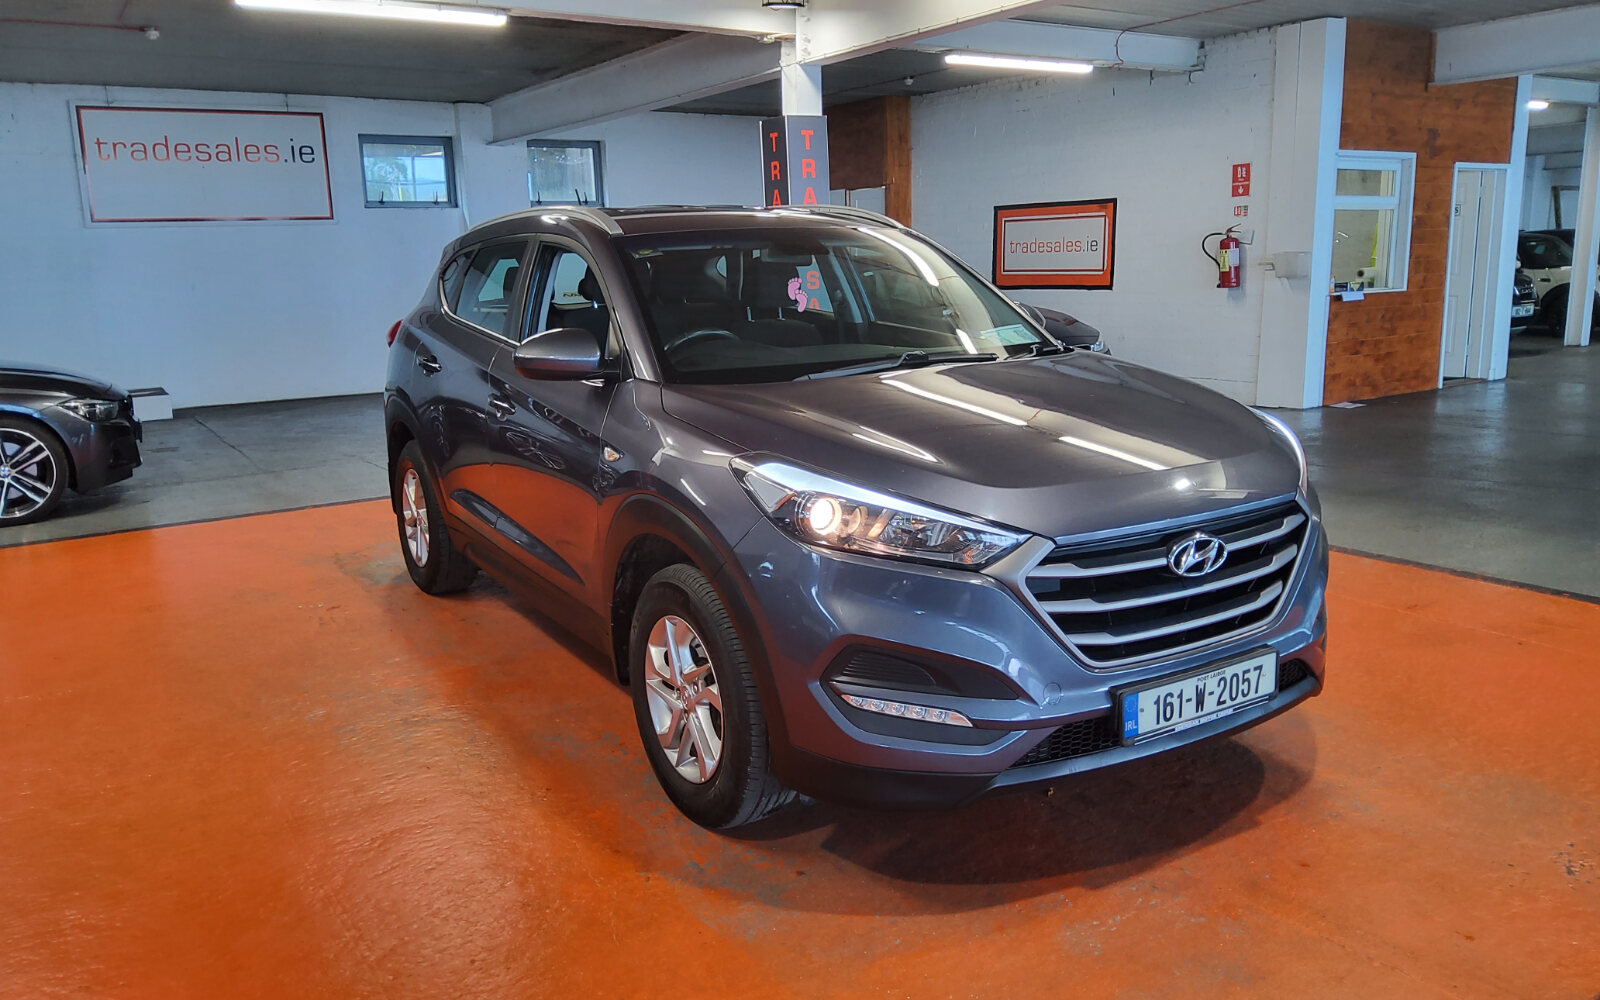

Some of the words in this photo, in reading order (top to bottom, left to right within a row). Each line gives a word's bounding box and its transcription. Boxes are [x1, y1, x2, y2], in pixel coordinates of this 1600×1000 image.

[94, 135, 316, 164] tradesales.ie
[1009, 235, 1099, 254] tradesales.ie
[1197, 674, 1210, 683] PORT
[1153, 664, 1264, 725] 161-W-2057
[1124, 720, 1138, 732] IRL
